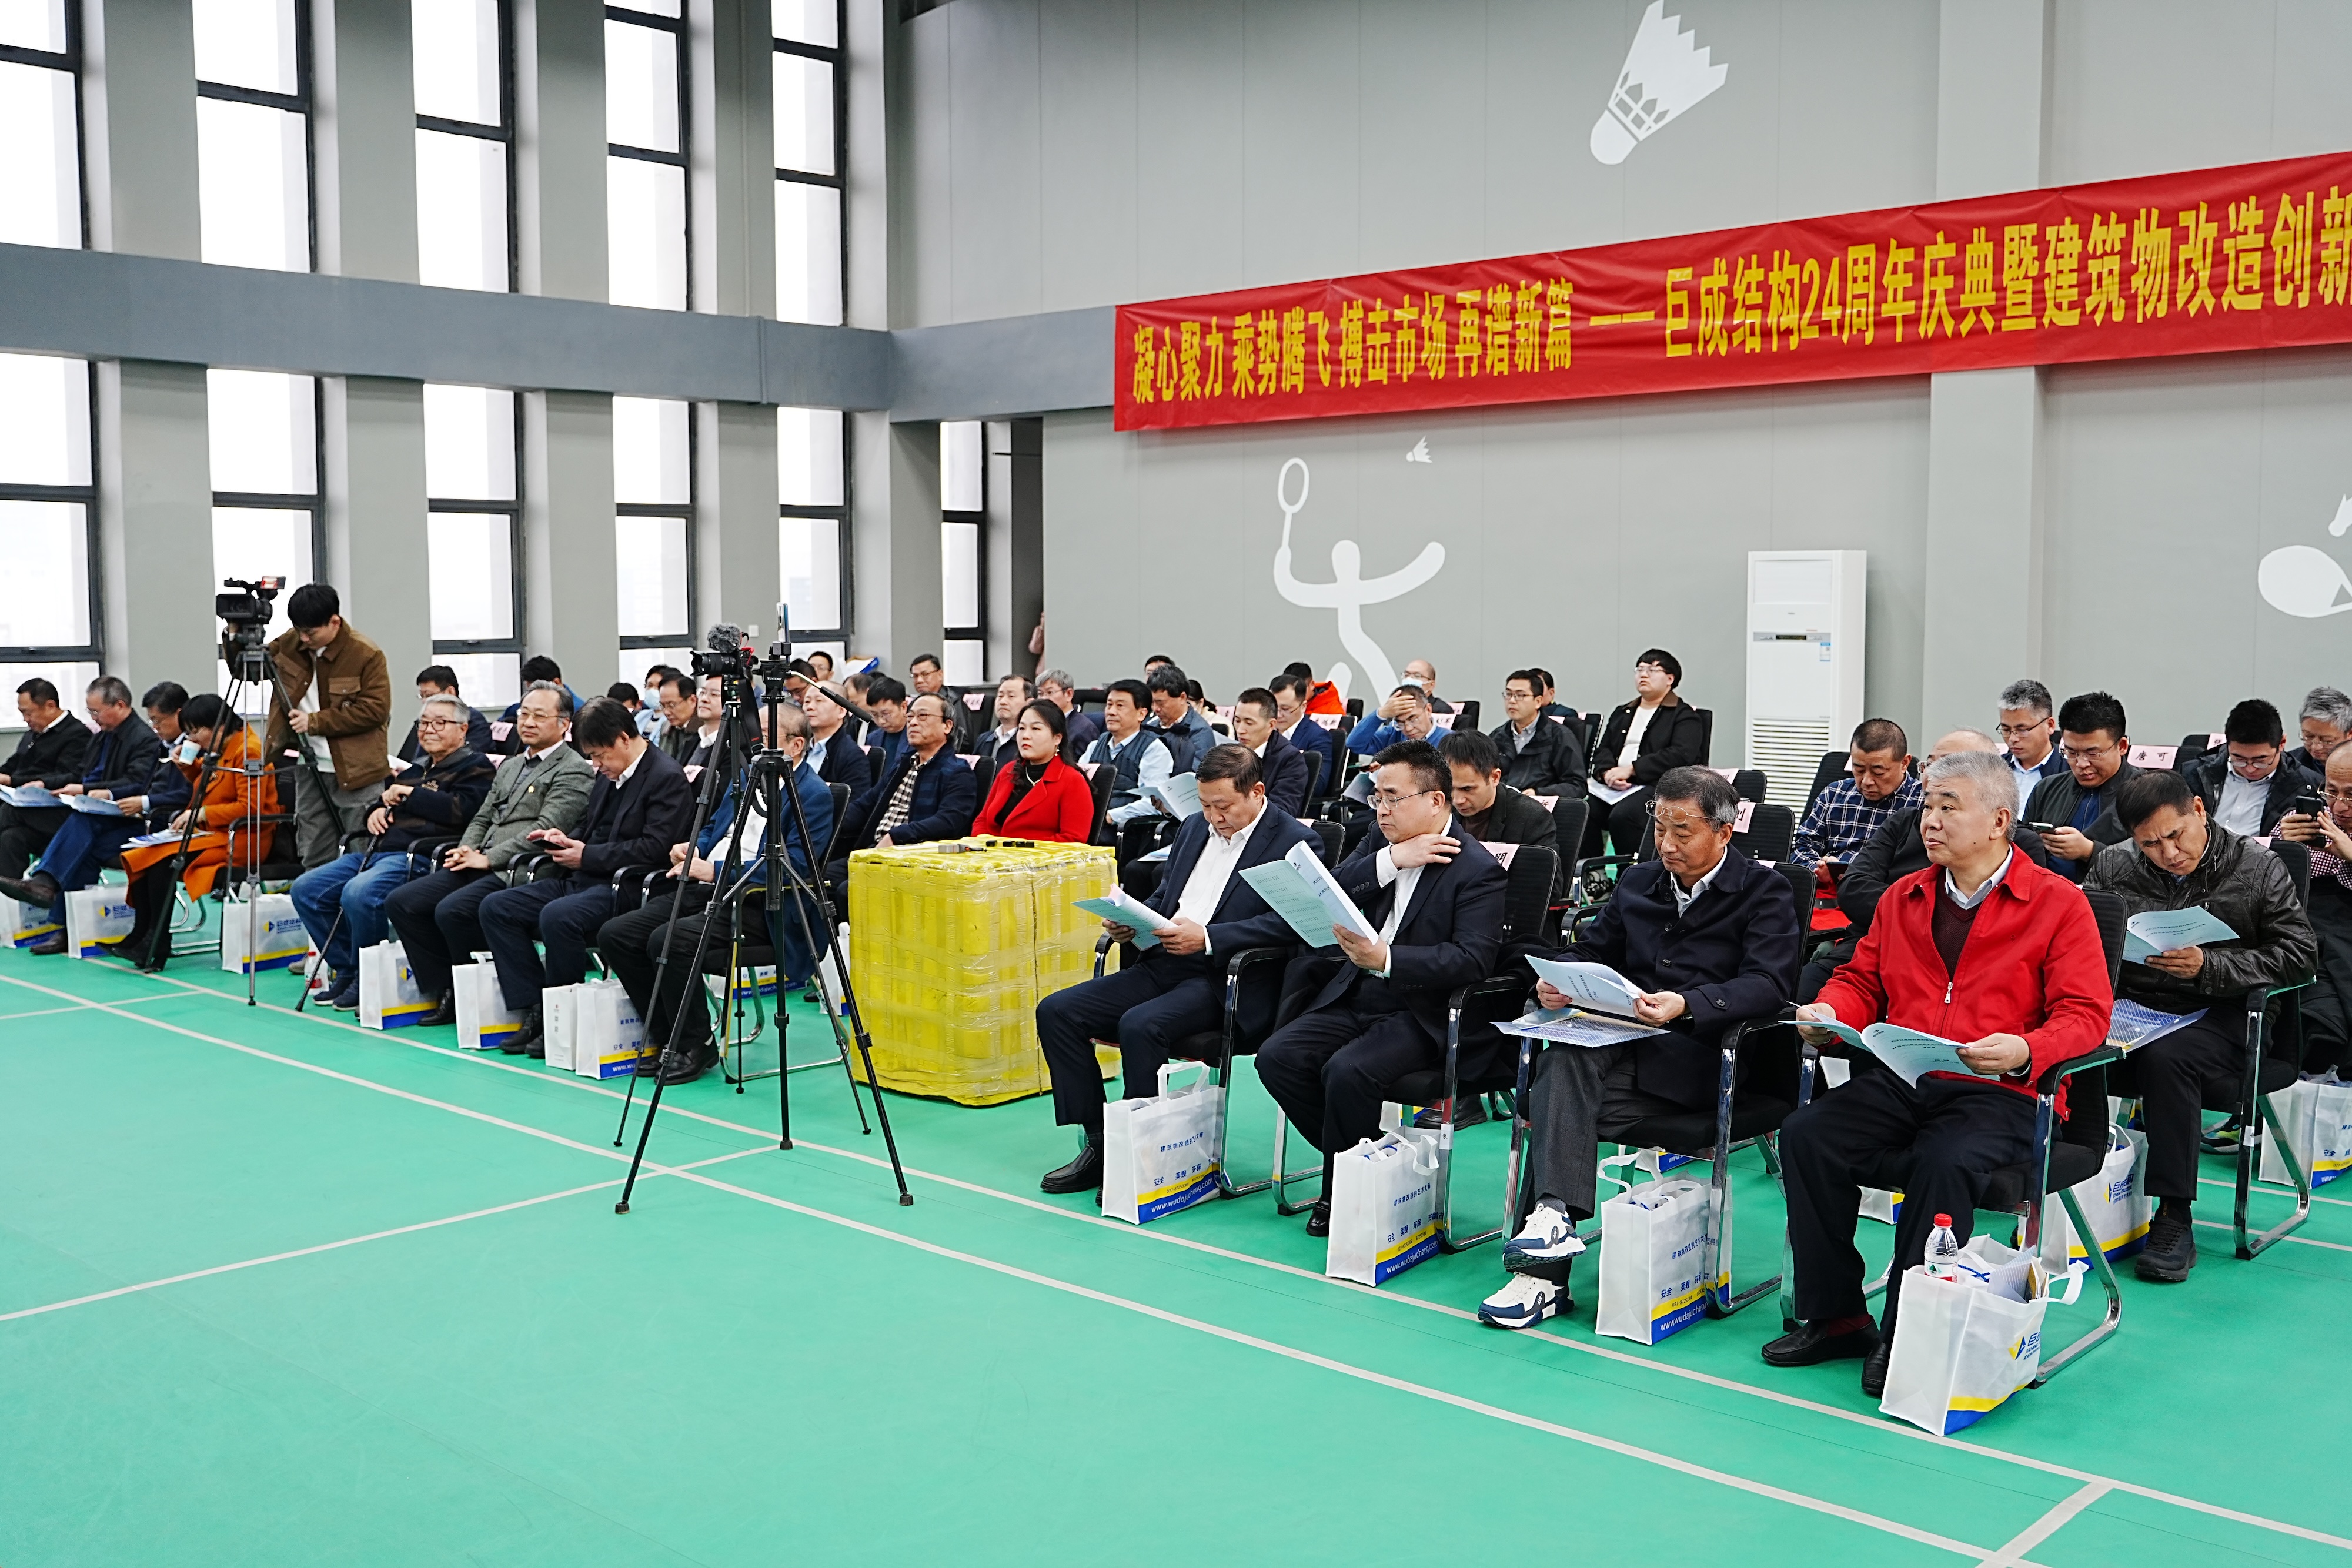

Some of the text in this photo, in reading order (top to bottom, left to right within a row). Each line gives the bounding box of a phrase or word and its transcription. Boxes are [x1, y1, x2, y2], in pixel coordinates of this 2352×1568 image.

[1154, 1163, 1201, 1186] 安全 美观 环保
[1151, 1178, 1214, 1213] www.wudajucheng.com
[1388, 1233, 1395, 1243] 安全
[1400, 1225, 1408, 1236] 美观
[1413, 1219, 1421, 1229] 环保
[1386, 1240, 1439, 1274] www.wudajucheng.com
[1661, 1287, 1672, 1299] 安全
[1681, 1279, 1690, 1292] 美观
